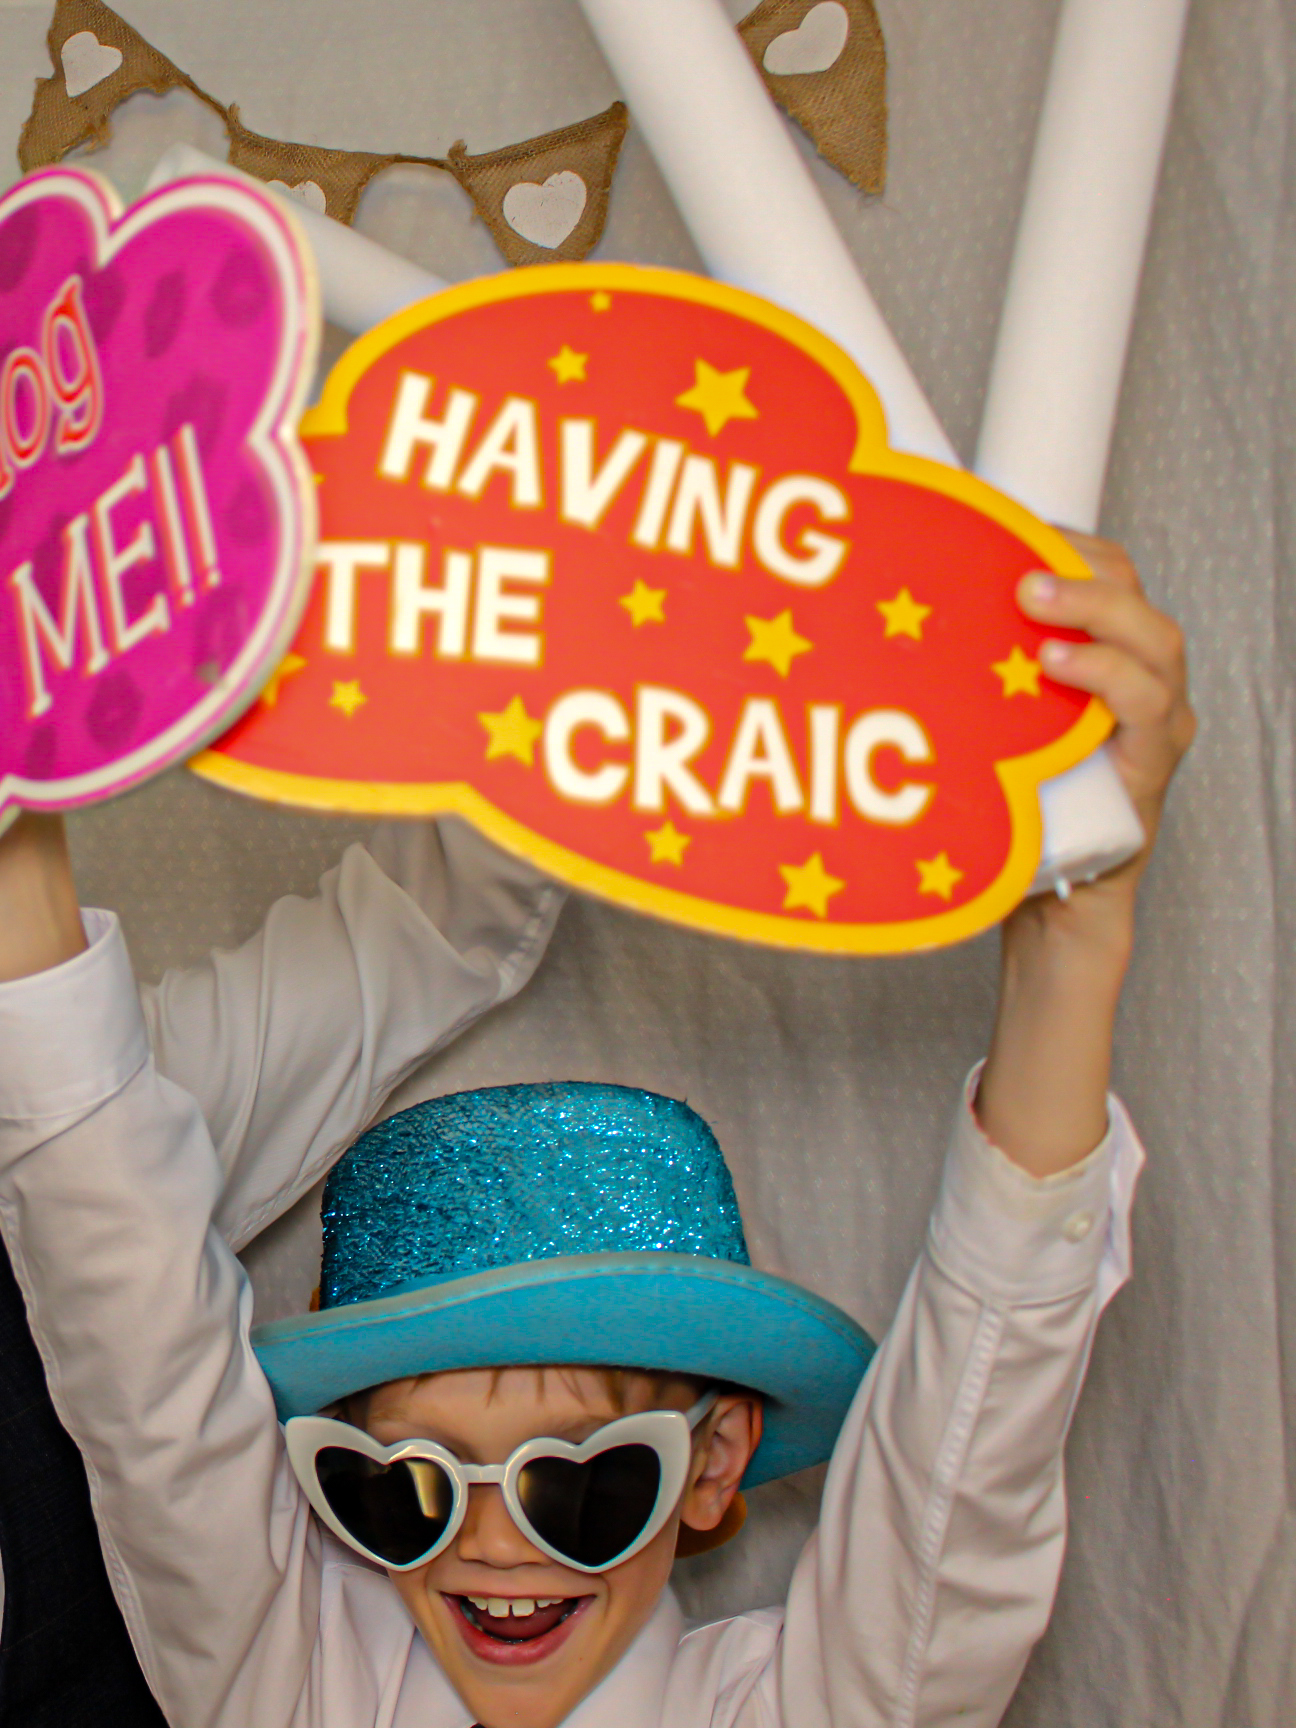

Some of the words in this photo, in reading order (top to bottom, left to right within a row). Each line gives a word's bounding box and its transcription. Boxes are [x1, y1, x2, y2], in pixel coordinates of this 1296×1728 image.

[378, 368, 851, 587] HAVING
[9, 423, 222, 718] ME!!
[313, 541, 552, 667] THE
[541, 684, 937, 827] CRAIC
